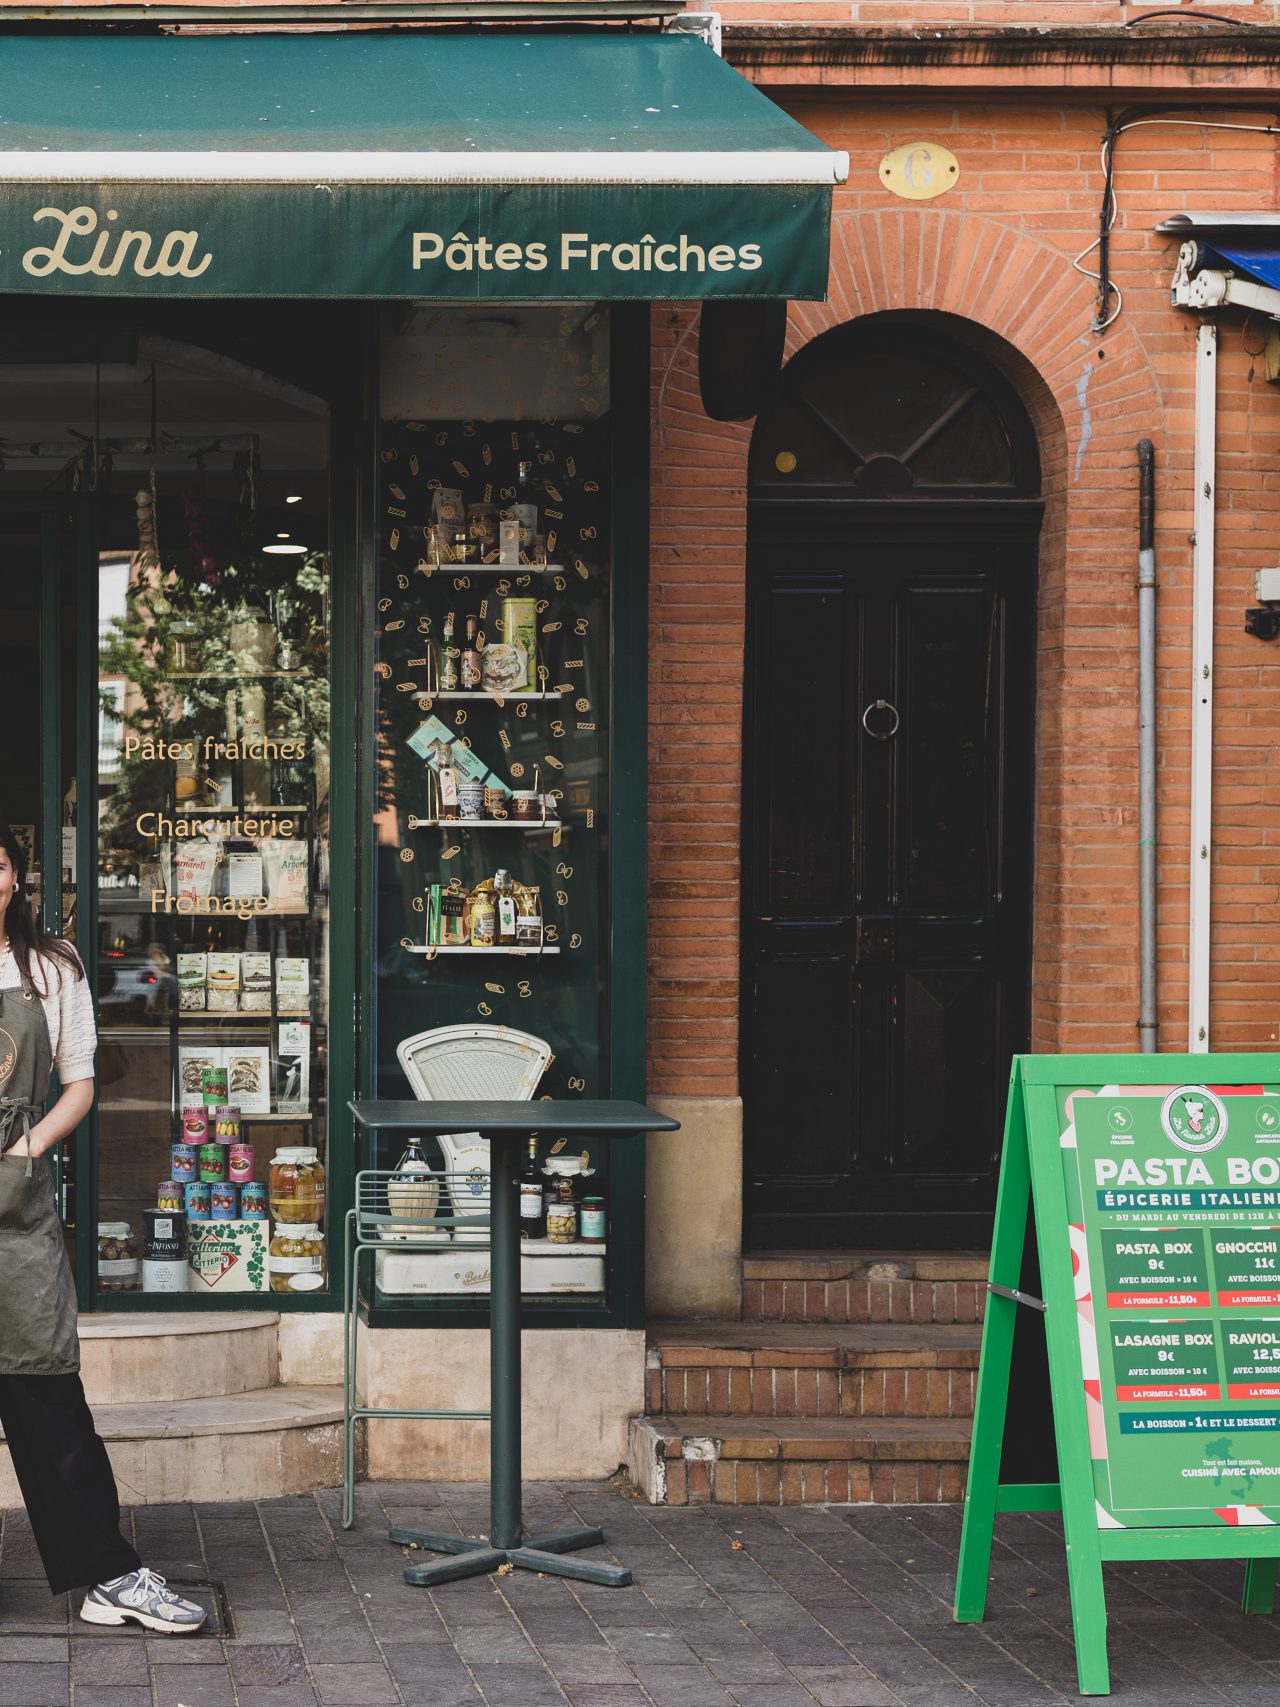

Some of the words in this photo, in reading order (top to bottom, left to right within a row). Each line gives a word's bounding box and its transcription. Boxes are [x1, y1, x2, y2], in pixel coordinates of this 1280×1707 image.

[904, 148, 932, 190] 6
[21, 205, 214, 278] Lina
[412, 231, 548, 272] Pâtes
[560, 233, 764, 272] Fraîches
[124, 735, 194, 761] Pâtes
[203, 735, 306, 761] fraîches
[135, 812, 294, 838] Charcuterie
[1181, 1129, 1206, 1141] Nonna
[1094, 1157, 1215, 1186] PASTA
[1226, 1156, 1280, 1186] BO
[1104, 1190, 1192, 1207] ÉPICERIE
[1116, 1213, 1130, 1221] DU
[1132, 1213, 1163, 1221] MARDI
[1166, 1213, 1179, 1221] AU
[1183, 1212, 1230, 1221] VENDREDI
[1247, 1212, 1264, 1220] 12H
[1268, 1210, 1275, 1219] À
[1115, 1243, 1160, 1255] PASTA
[1164, 1242, 1193, 1254] BOX
[1215, 1242, 1277, 1254] GNOCCHI
[193, 1256, 228, 1267] CITTERIO
[1148, 1258, 1165, 1270] 9€
[1254, 1257, 1275, 1269] 11€
[1119, 1276, 1140, 1284] AVEC
[1140, 1276, 1175, 1284] BOISSON
[1228, 1275, 1249, 1283] AVEC
[1123, 1297, 1133, 1305] LA
[1133, 1297, 1164, 1305] FORMULE
[1168, 1295, 1197, 1304] 11,50€
[1114, 1334, 1181, 1347] LASAGNE
[1184, 1333, 1214, 1345] BOX
[1229, 1332, 1280, 1345] RAVIOL
[1157, 1350, 1175, 1362] 9€
[1128, 1368, 1149, 1376] AVEC
[1150, 1367, 1185, 1375] BOISSON
[1192, 1367, 1201, 1375] 10
[1233, 1366, 1254, 1374] AVEC
[1142, 1390, 1174, 1398] FORMULE
[1132, 1420, 1145, 1429] LA
[1146, 1419, 1186, 1429] BOISSON
[1195, 1416, 1208, 1428] 1€
[1209, 1419, 1221, 1427] ET
[1223, 1418, 1235, 1427] LE
[1236, 1418, 1276, 1427] DESSERT
[1226, 1458, 1237, 1466] fait
[1238, 1458, 1263, 1466] maison,
[1181, 1466, 1219, 1477] CUISINÉ
[1221, 1467, 1247, 1477] AVEC
